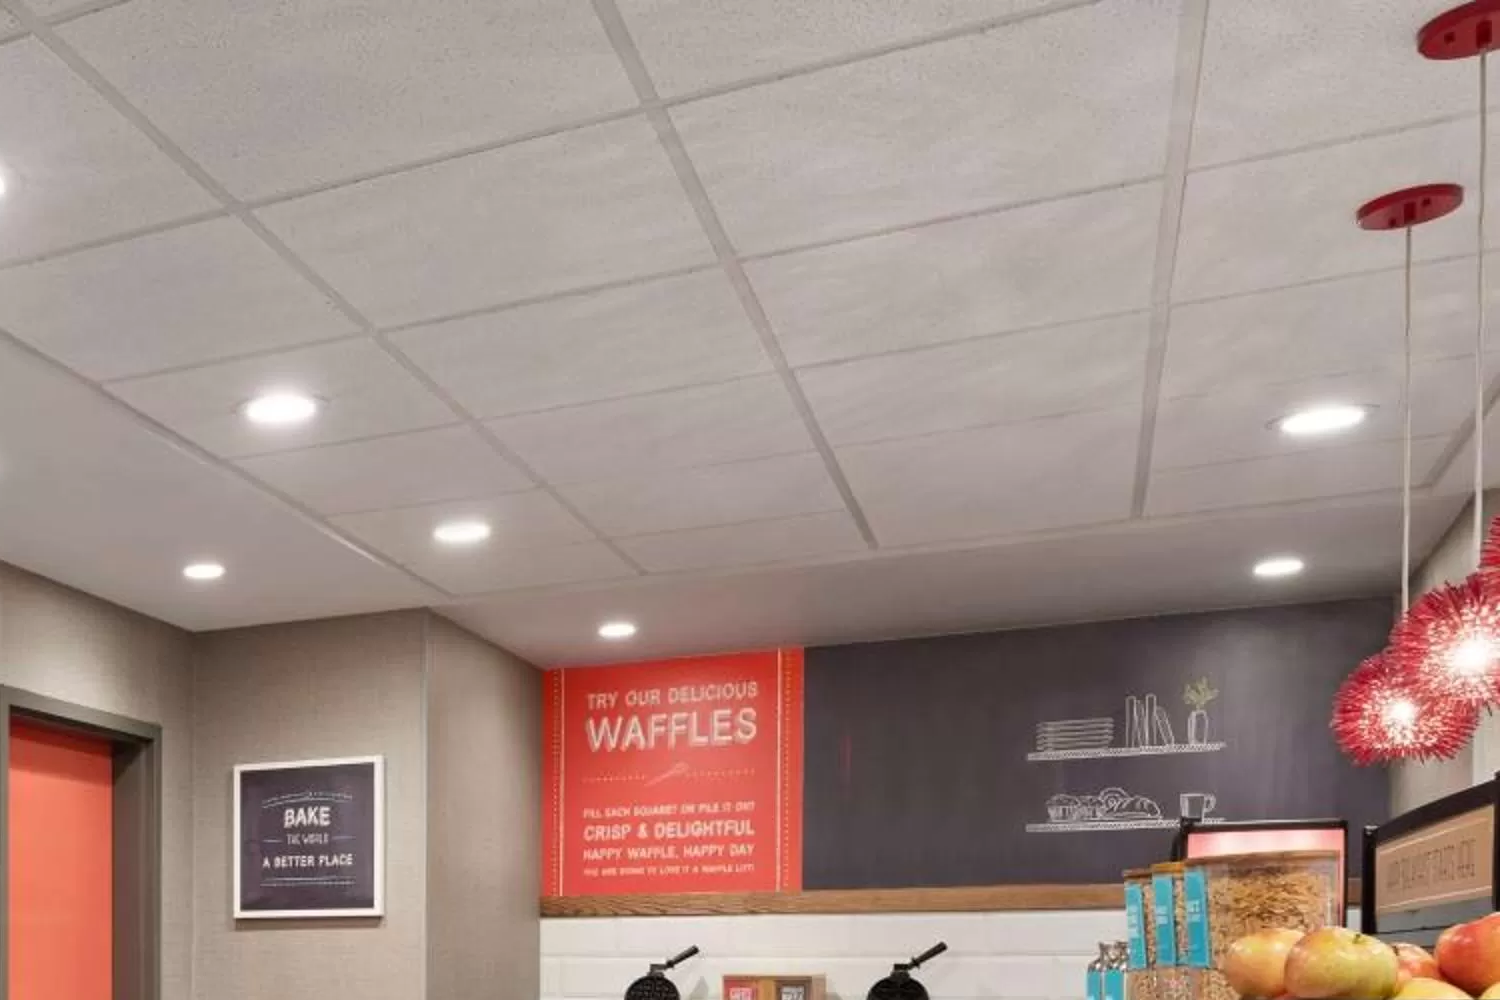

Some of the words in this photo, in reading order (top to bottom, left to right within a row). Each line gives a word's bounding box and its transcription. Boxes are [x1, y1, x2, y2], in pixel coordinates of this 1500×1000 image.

[587, 692, 618, 710] TRY
[625, 689, 661, 705] OUR
[668, 681, 758, 704] DELICIOUS
[586, 707, 758, 752] WAFFLES
[284, 806, 331, 828] BAKE
[583, 823, 631, 842] CRISP
[637, 823, 648, 840] &
[654, 819, 756, 840] DELIGHTFUL
[262, 857, 271, 868] A
[274, 855, 315, 868] BETTER
[319, 853, 353, 867] PLACE
[583, 848, 623, 861] HAPPY
[683, 844, 723, 857] HAPPY
[729, 843, 756, 857] DAY
